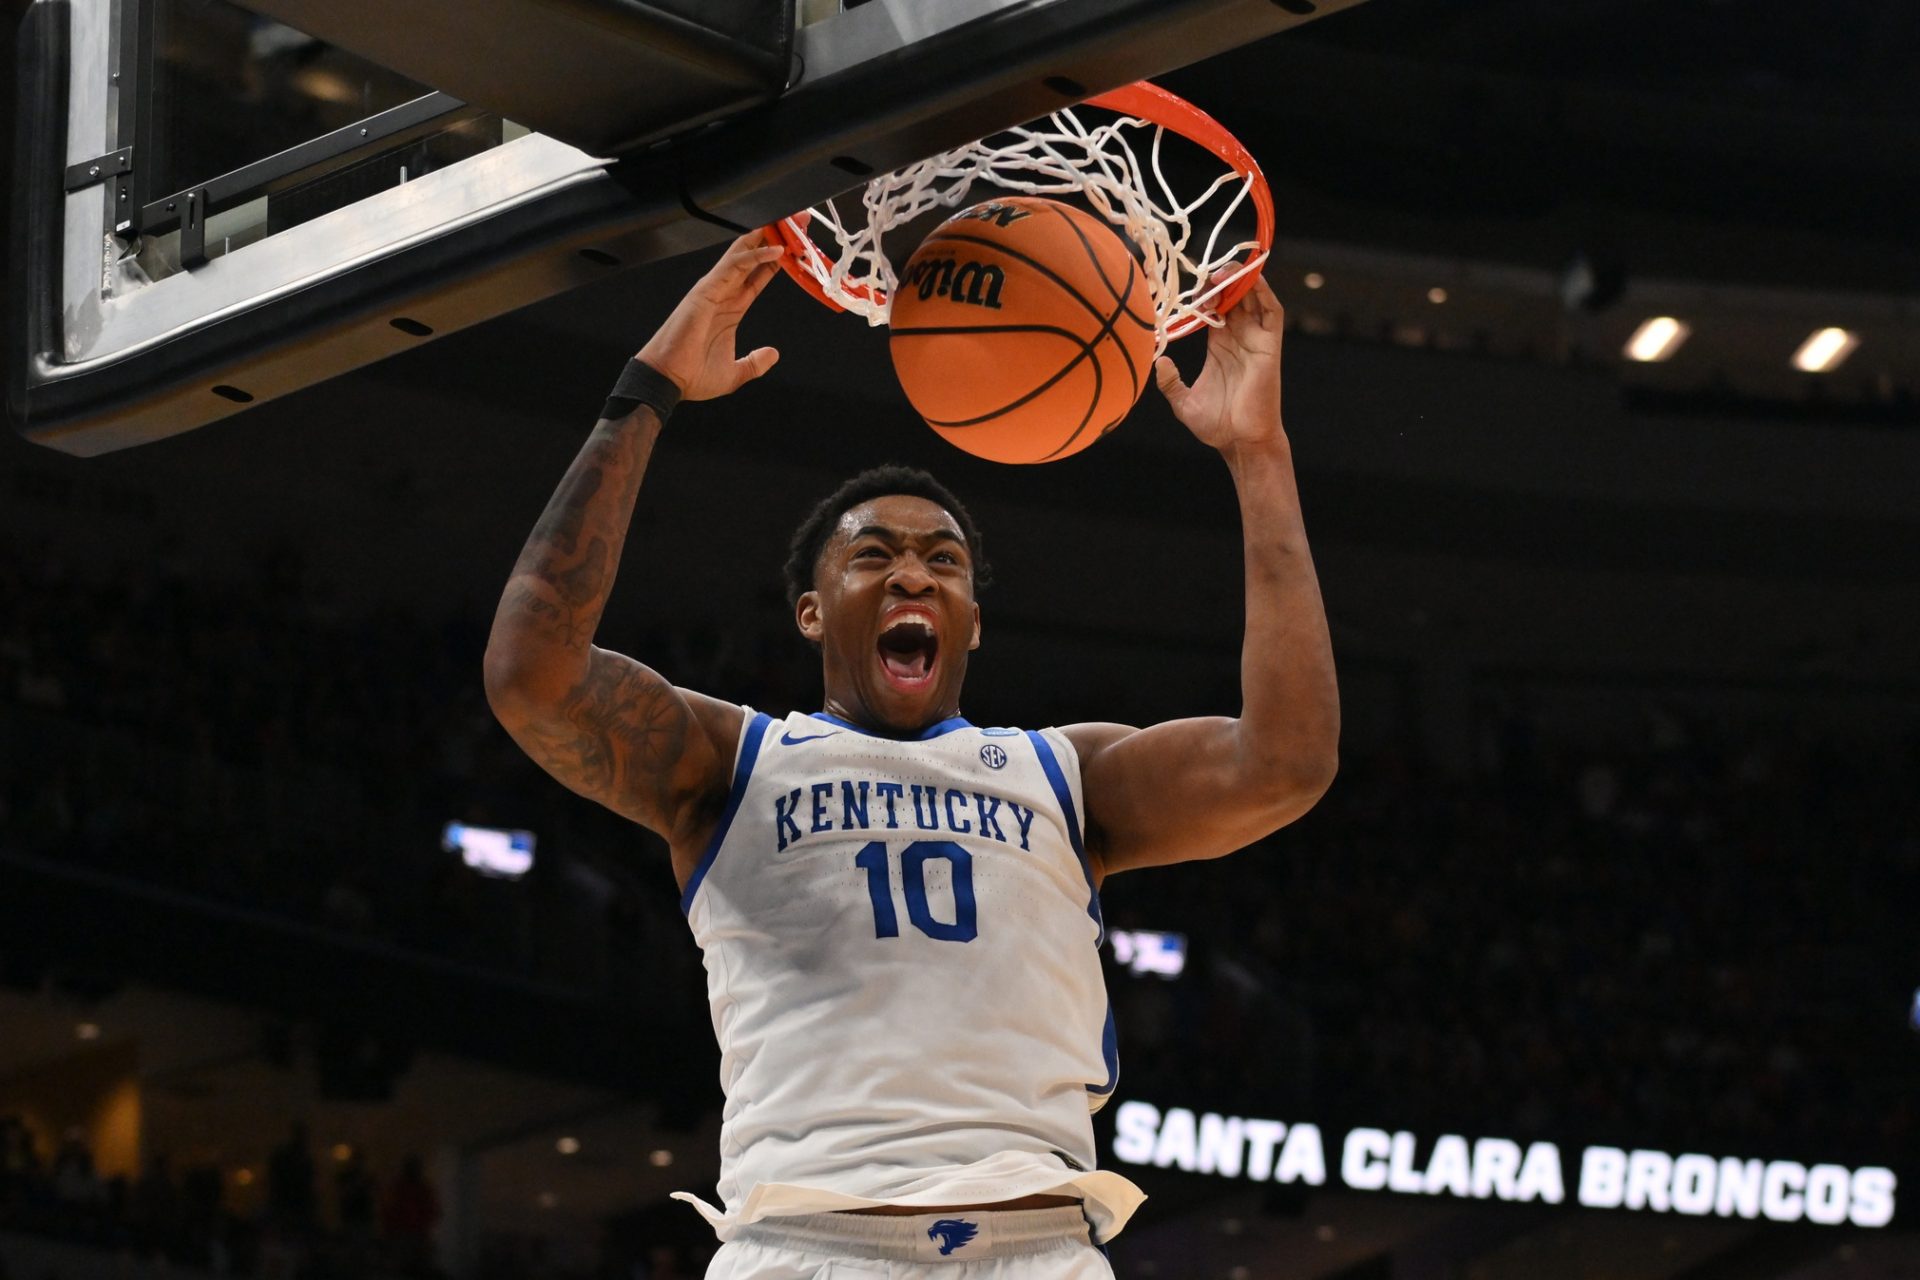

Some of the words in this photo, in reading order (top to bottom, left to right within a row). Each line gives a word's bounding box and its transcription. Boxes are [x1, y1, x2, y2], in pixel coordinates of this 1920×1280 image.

[981, 745, 1006, 769] SEC
[775, 781, 1034, 852] KENTUCKY
[855, 841, 978, 943] 10
[1113, 1101, 1326, 1186] SANTA
[1341, 1128, 1565, 1204] CLARA
[1578, 1145, 1897, 1228] BRONCOS
